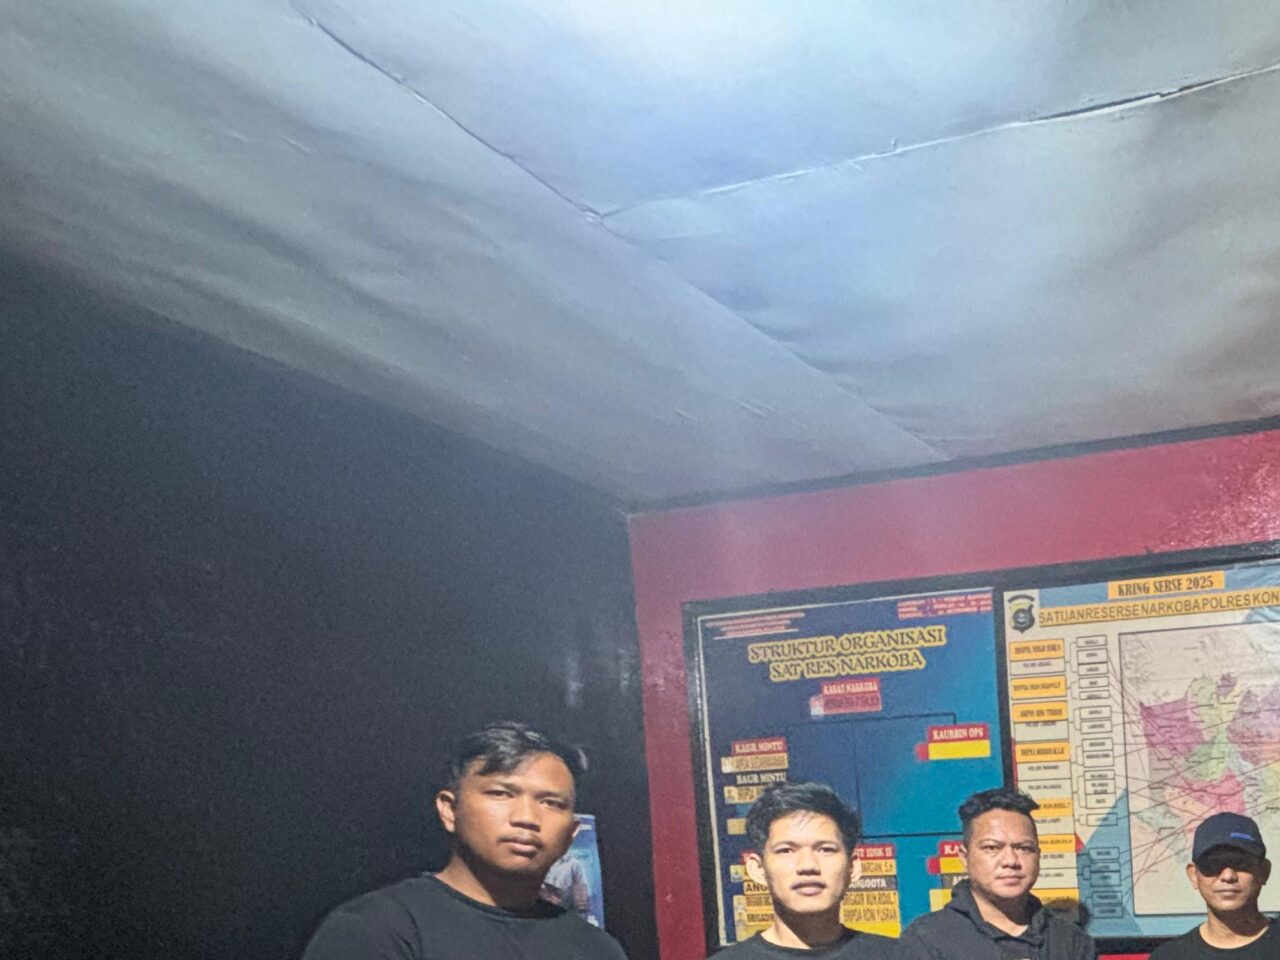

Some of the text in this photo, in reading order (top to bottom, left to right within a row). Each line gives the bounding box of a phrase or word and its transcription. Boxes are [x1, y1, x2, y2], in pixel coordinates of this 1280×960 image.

[1118, 575, 1214, 596] KRING SERSE 2025
[750, 628, 943, 660] STRUKTUR ORGANISASI
[772, 650, 923, 679] SAT RES NARKOBA
